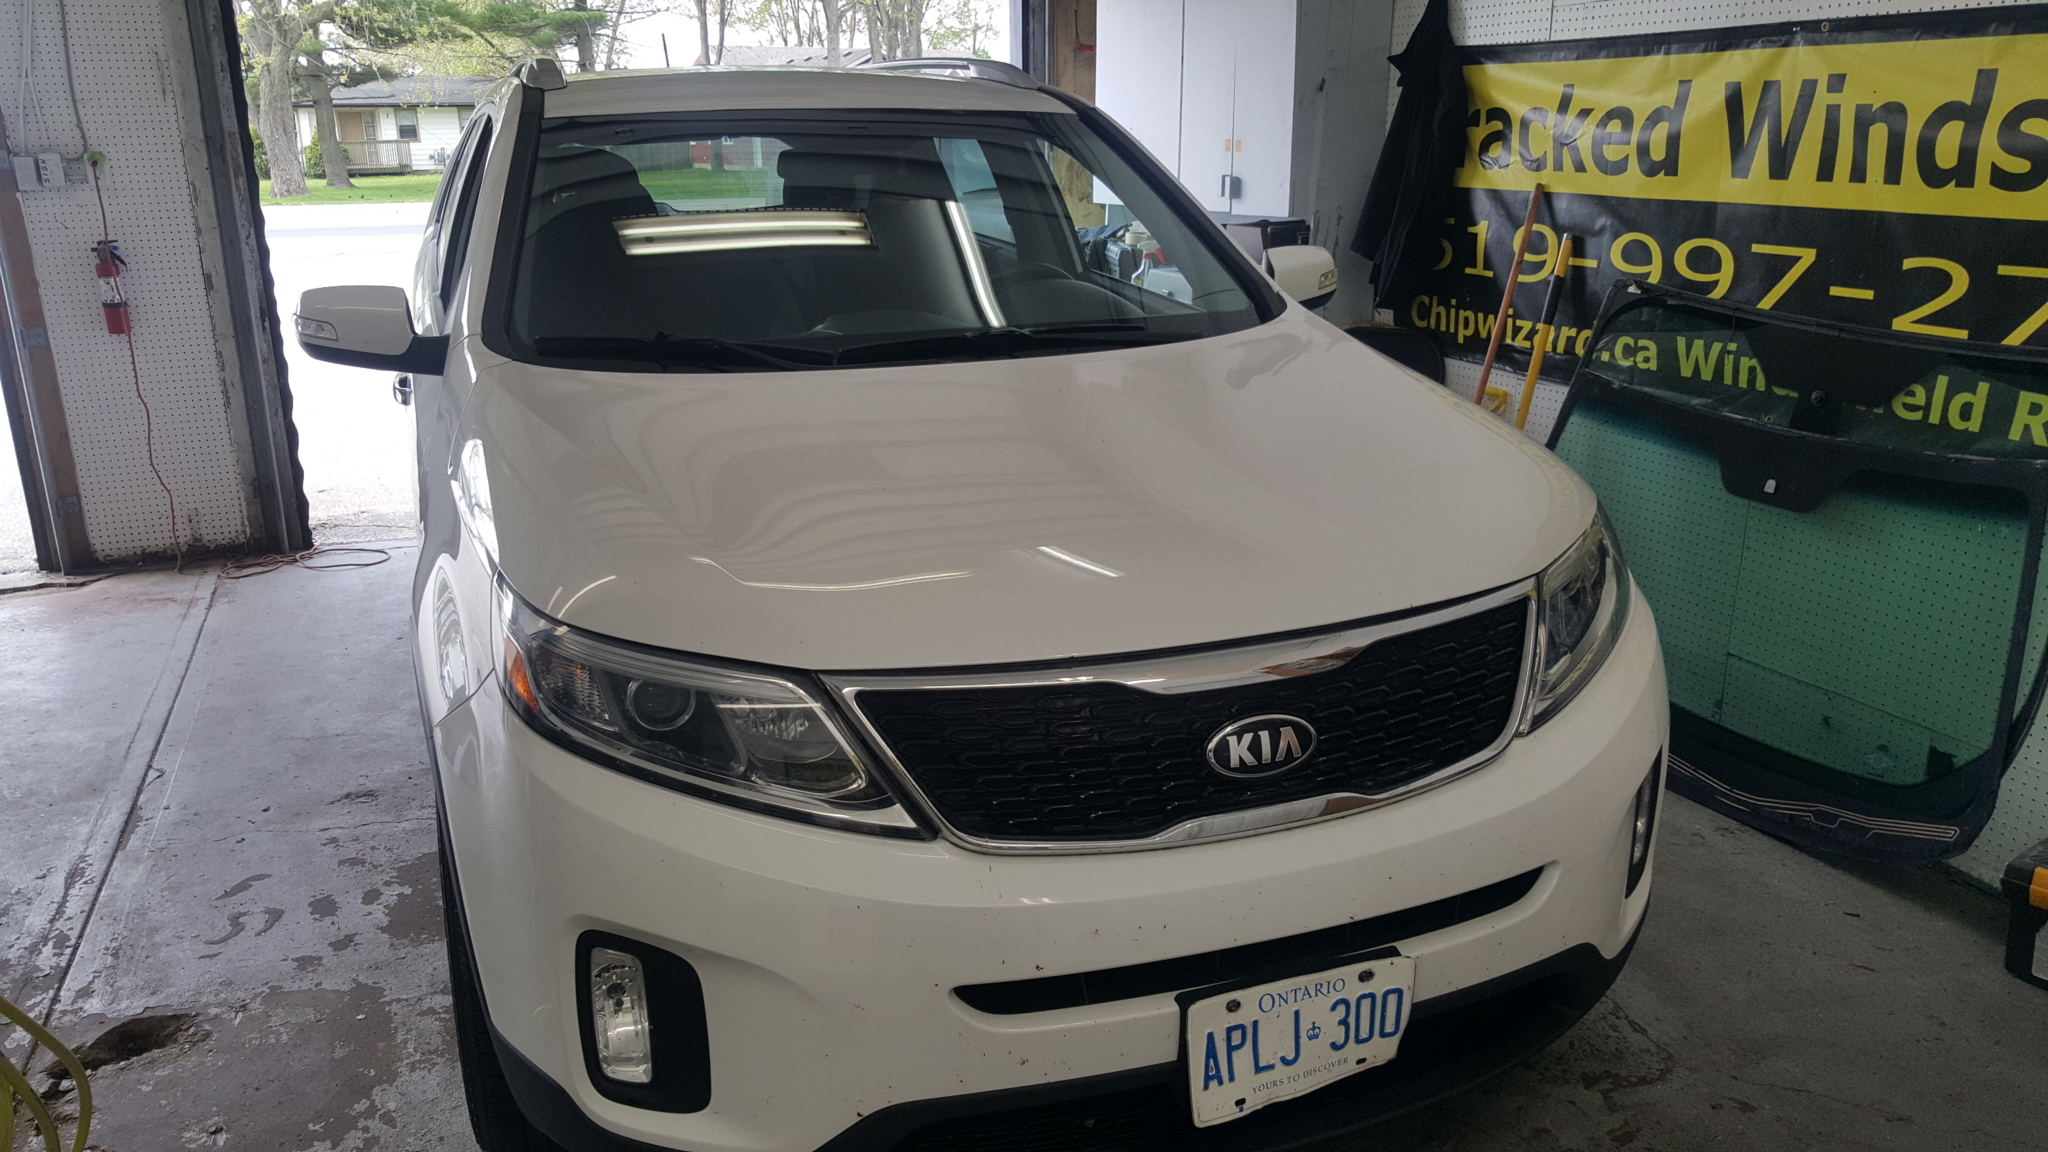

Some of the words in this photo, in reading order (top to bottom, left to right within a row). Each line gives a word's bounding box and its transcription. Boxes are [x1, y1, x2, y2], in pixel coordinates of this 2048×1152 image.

[1725, 68, 2048, 193] Winds
[40, 158, 51, 184] SIGN
[1226, 726, 1302, 768] KIA
[1258, 978, 1346, 1013] ONTARIO
[1203, 1009, 1301, 1091] APLJ
[1329, 987, 1404, 1051] 300
[1251, 1079, 1284, 1094] YOURS
[1286, 1073, 1300, 1085] TO
[1302, 1057, 1349, 1079] DISCOVER
